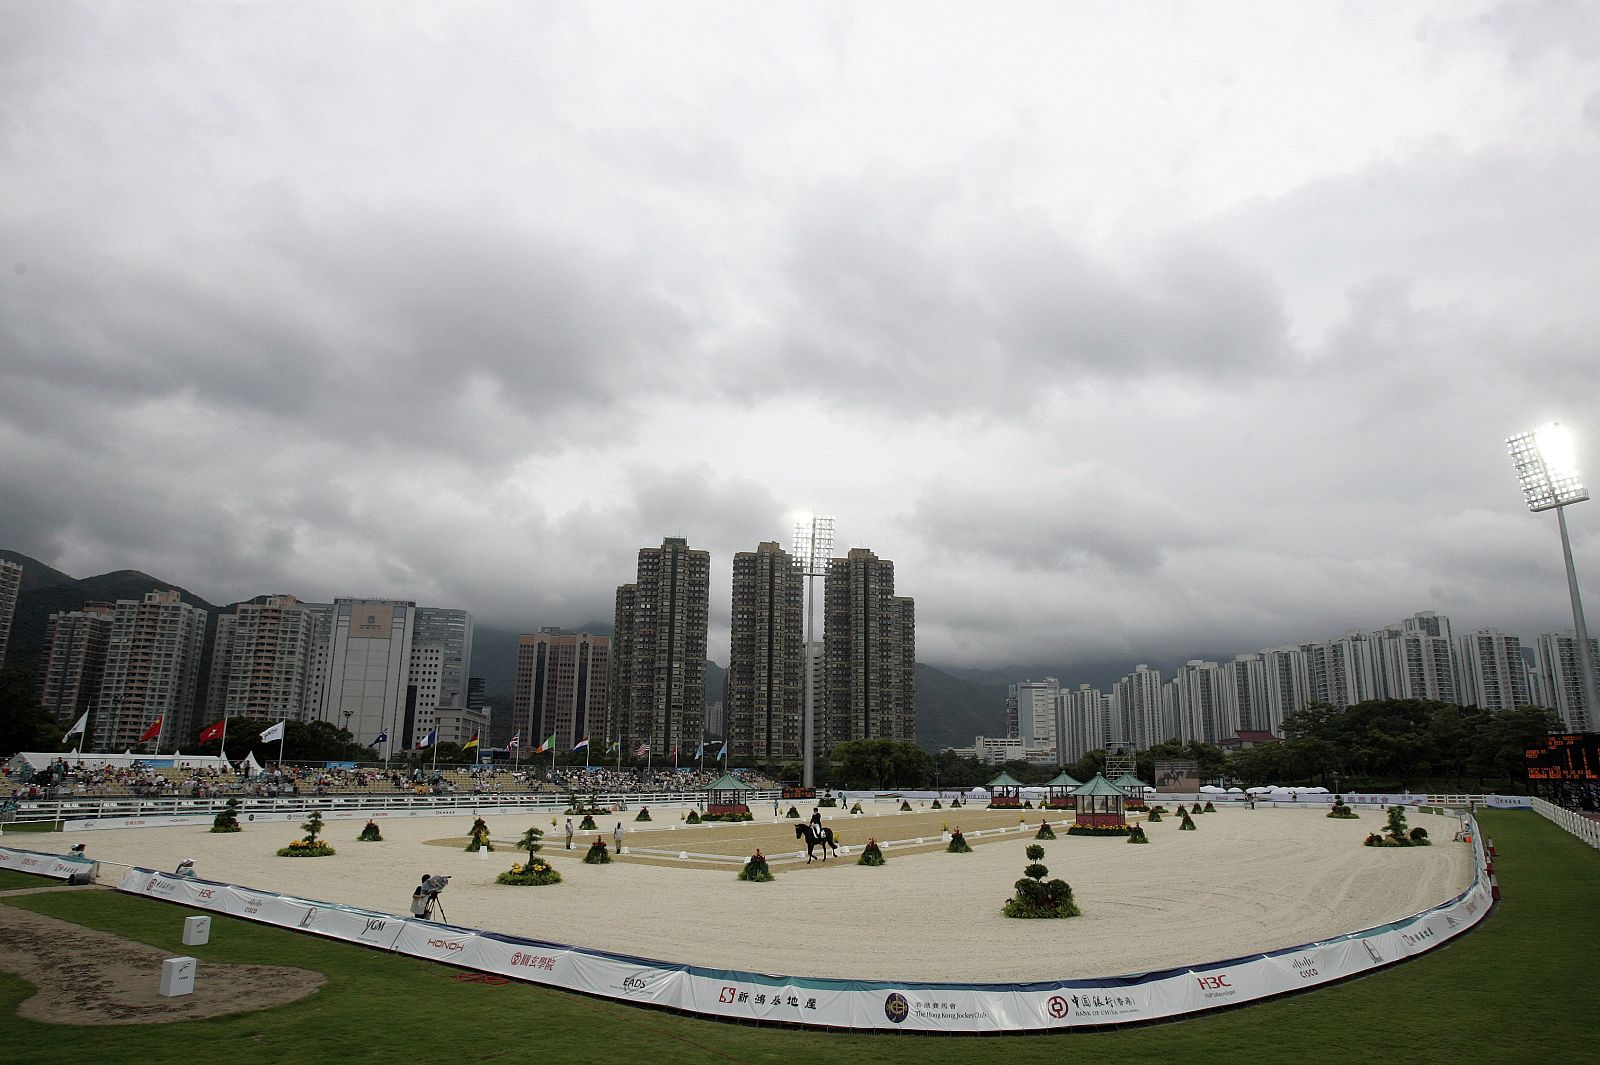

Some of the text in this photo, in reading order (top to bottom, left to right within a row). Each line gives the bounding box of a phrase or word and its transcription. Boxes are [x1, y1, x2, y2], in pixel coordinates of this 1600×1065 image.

[198, 888, 216, 899] H3C
[361, 917, 387, 936] YGM
[623, 977, 646, 989] EADS
[1197, 974, 1232, 990] H3C
[915, 1010, 926, 1018] The
[926, 1011, 941, 1019] Hong
[941, 1012, 956, 1020] Kong
[956, 1012, 975, 1020] Jockey
